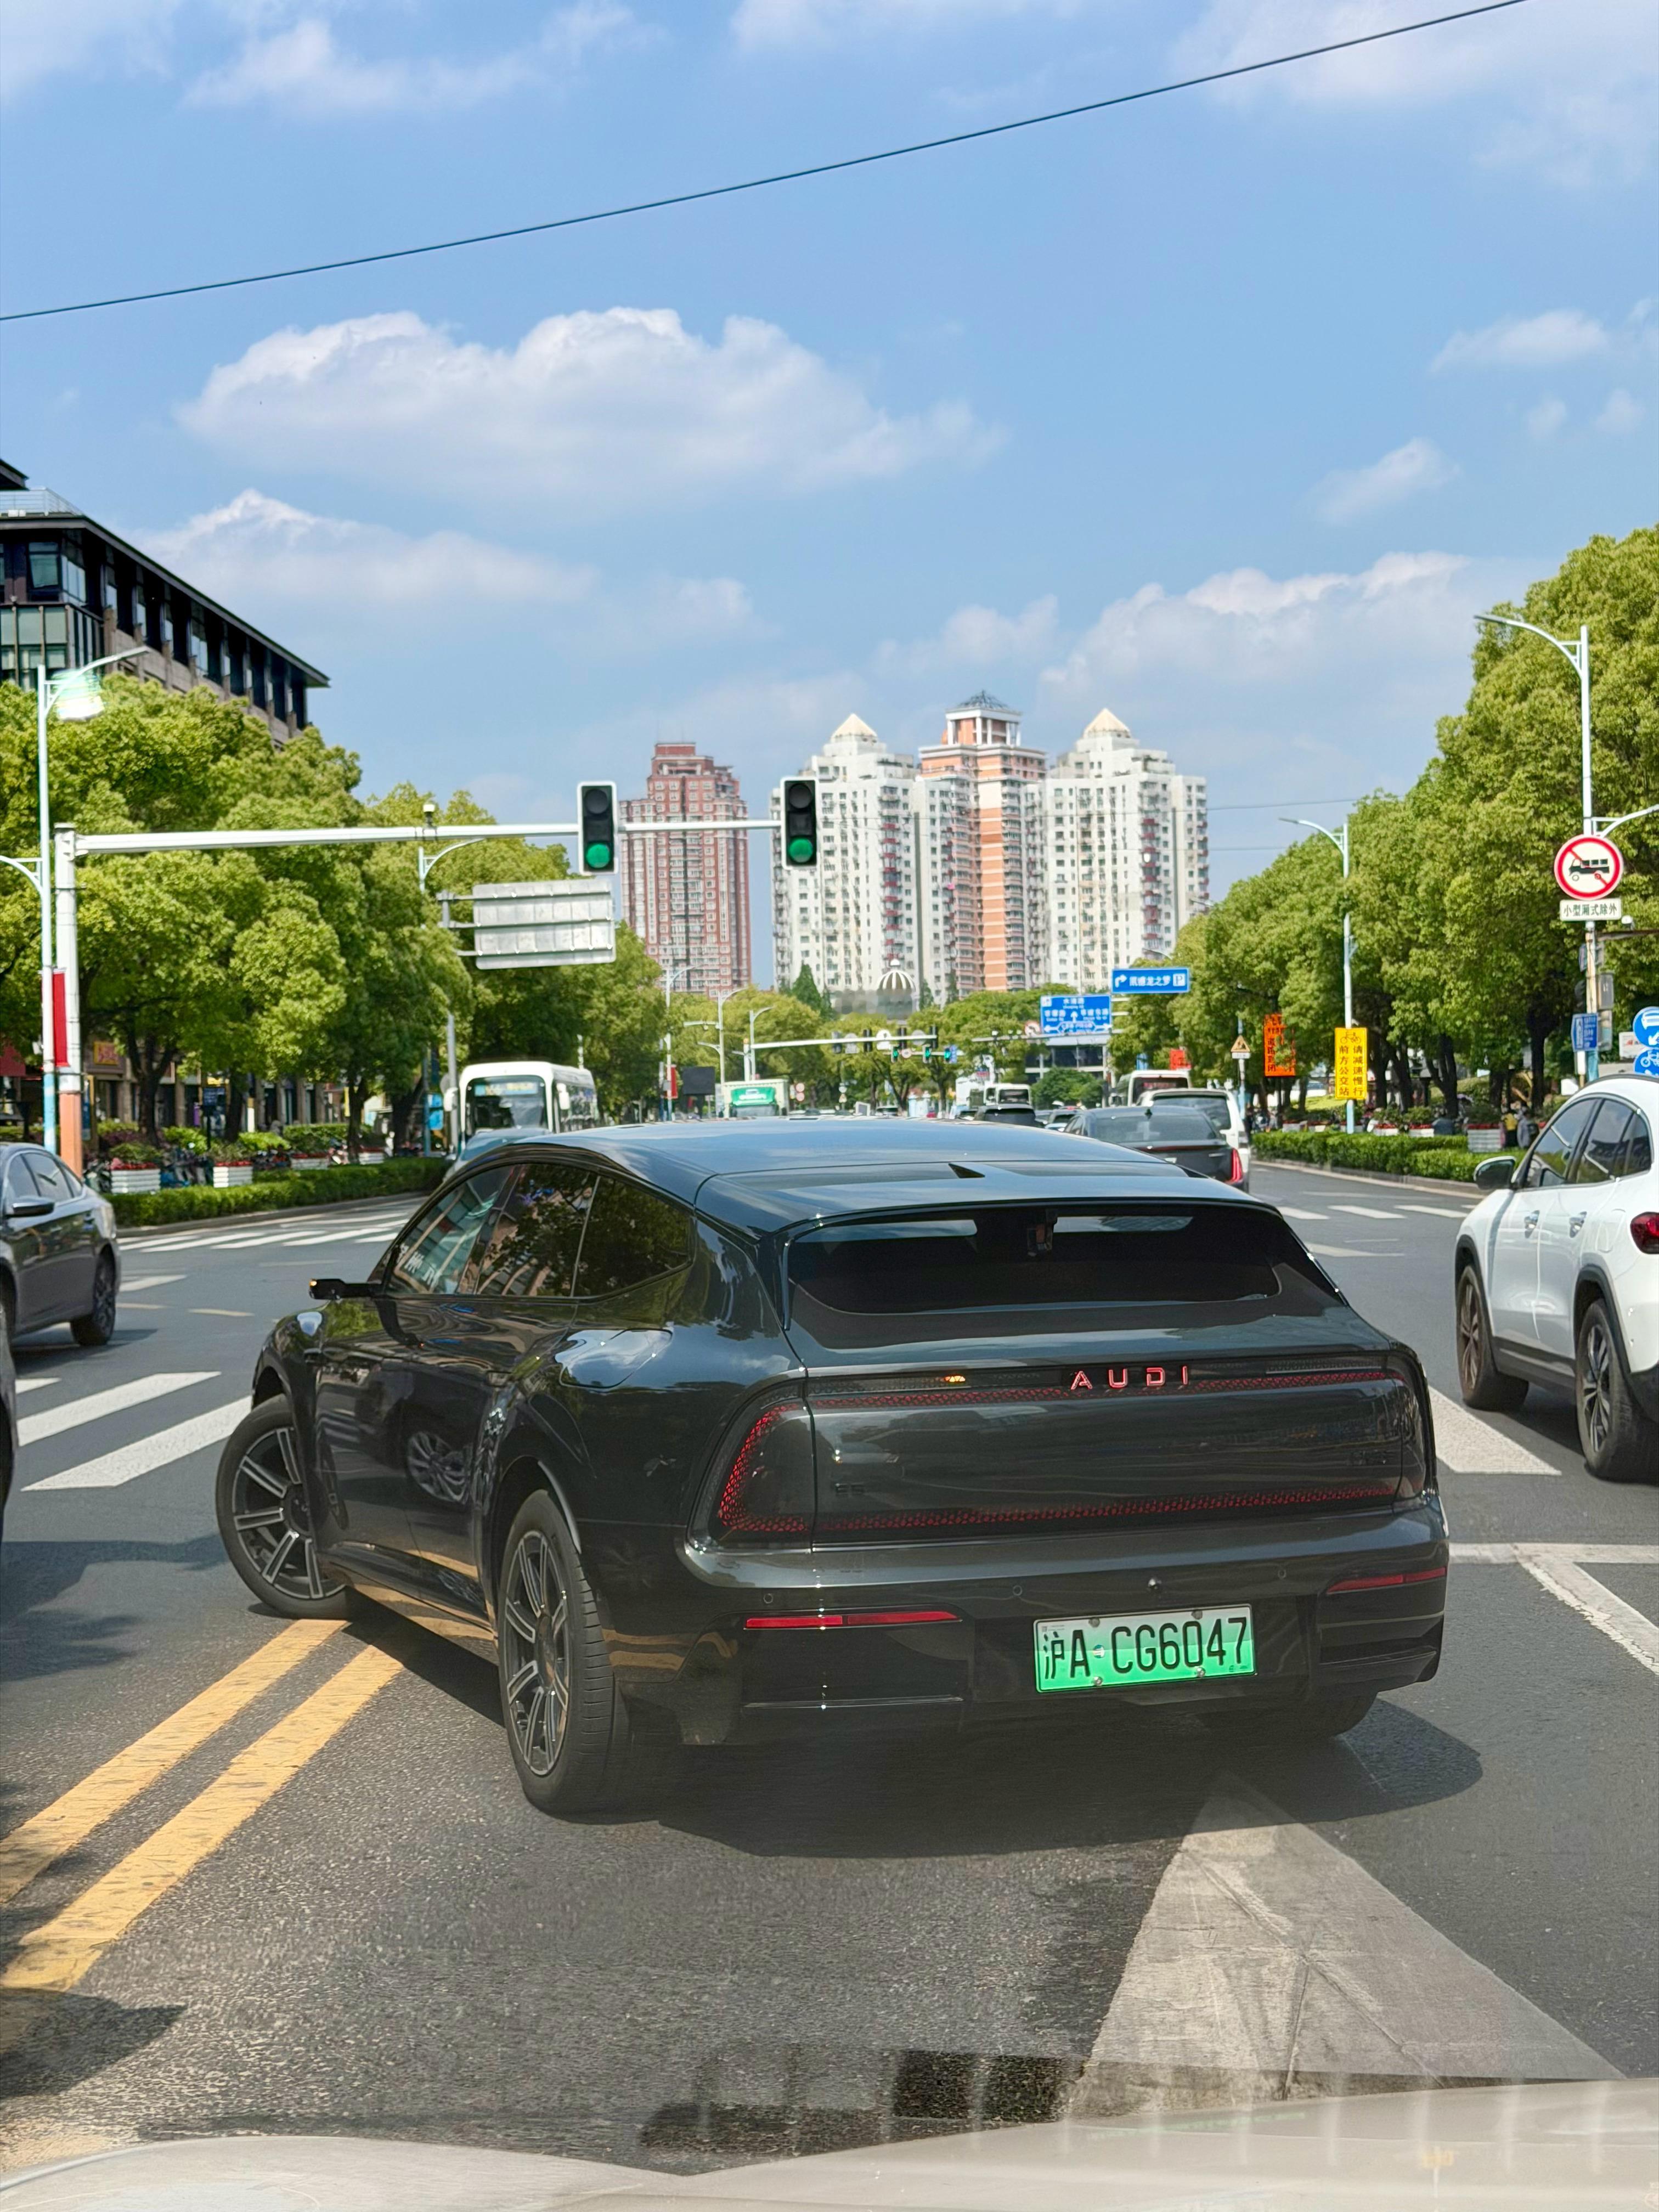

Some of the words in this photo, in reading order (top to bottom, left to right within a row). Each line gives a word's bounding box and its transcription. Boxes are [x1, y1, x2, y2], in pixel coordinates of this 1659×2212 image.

[1563, 902, 1617, 917] 小型厢式除外
[1339, 1045, 1349, 1096] 前方公交站
[1353, 1045, 1363, 1096] 请减速慢行
[1070, 1365, 1188, 1390] AUDI
